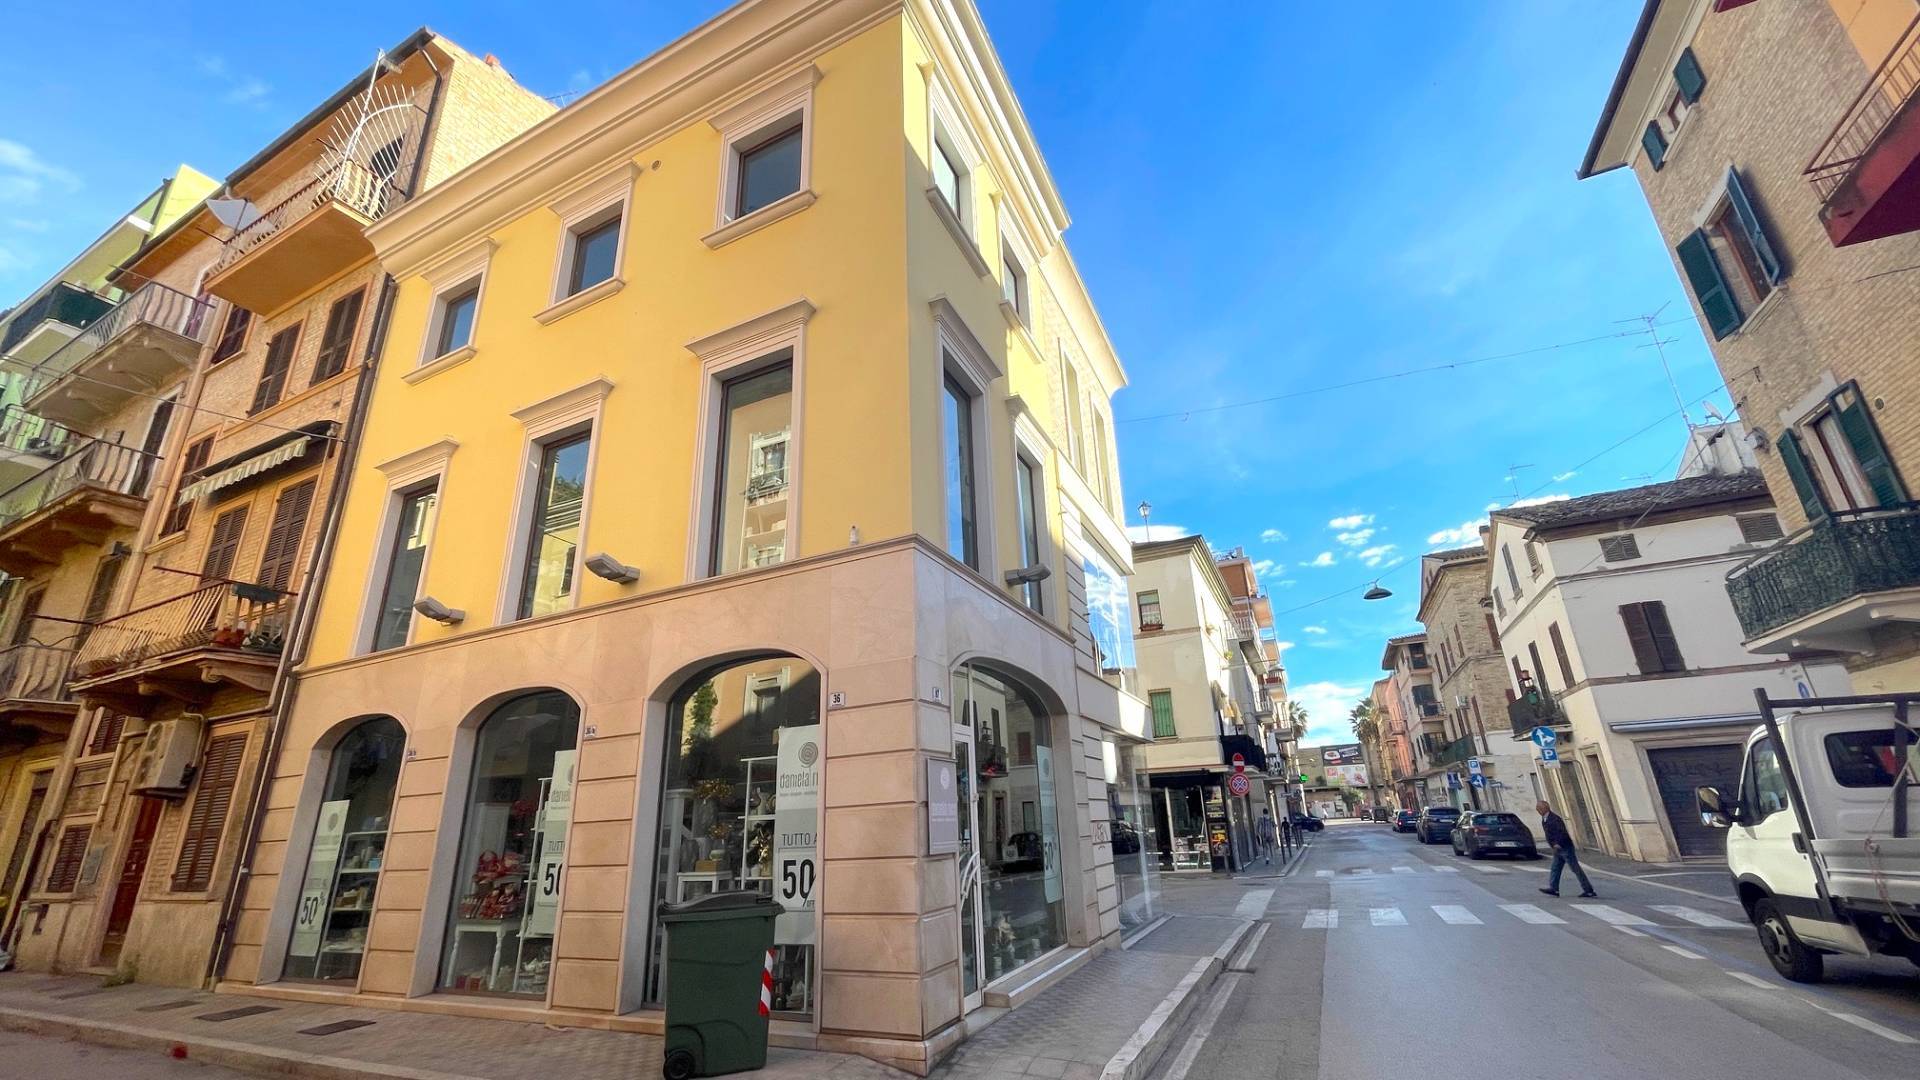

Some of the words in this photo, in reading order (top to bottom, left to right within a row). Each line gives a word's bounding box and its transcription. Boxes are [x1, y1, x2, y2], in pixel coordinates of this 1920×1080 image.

[832, 693, 841, 704] 36
[1544, 750, 1553, 759] P
[782, 832, 811, 846] TUTTO
